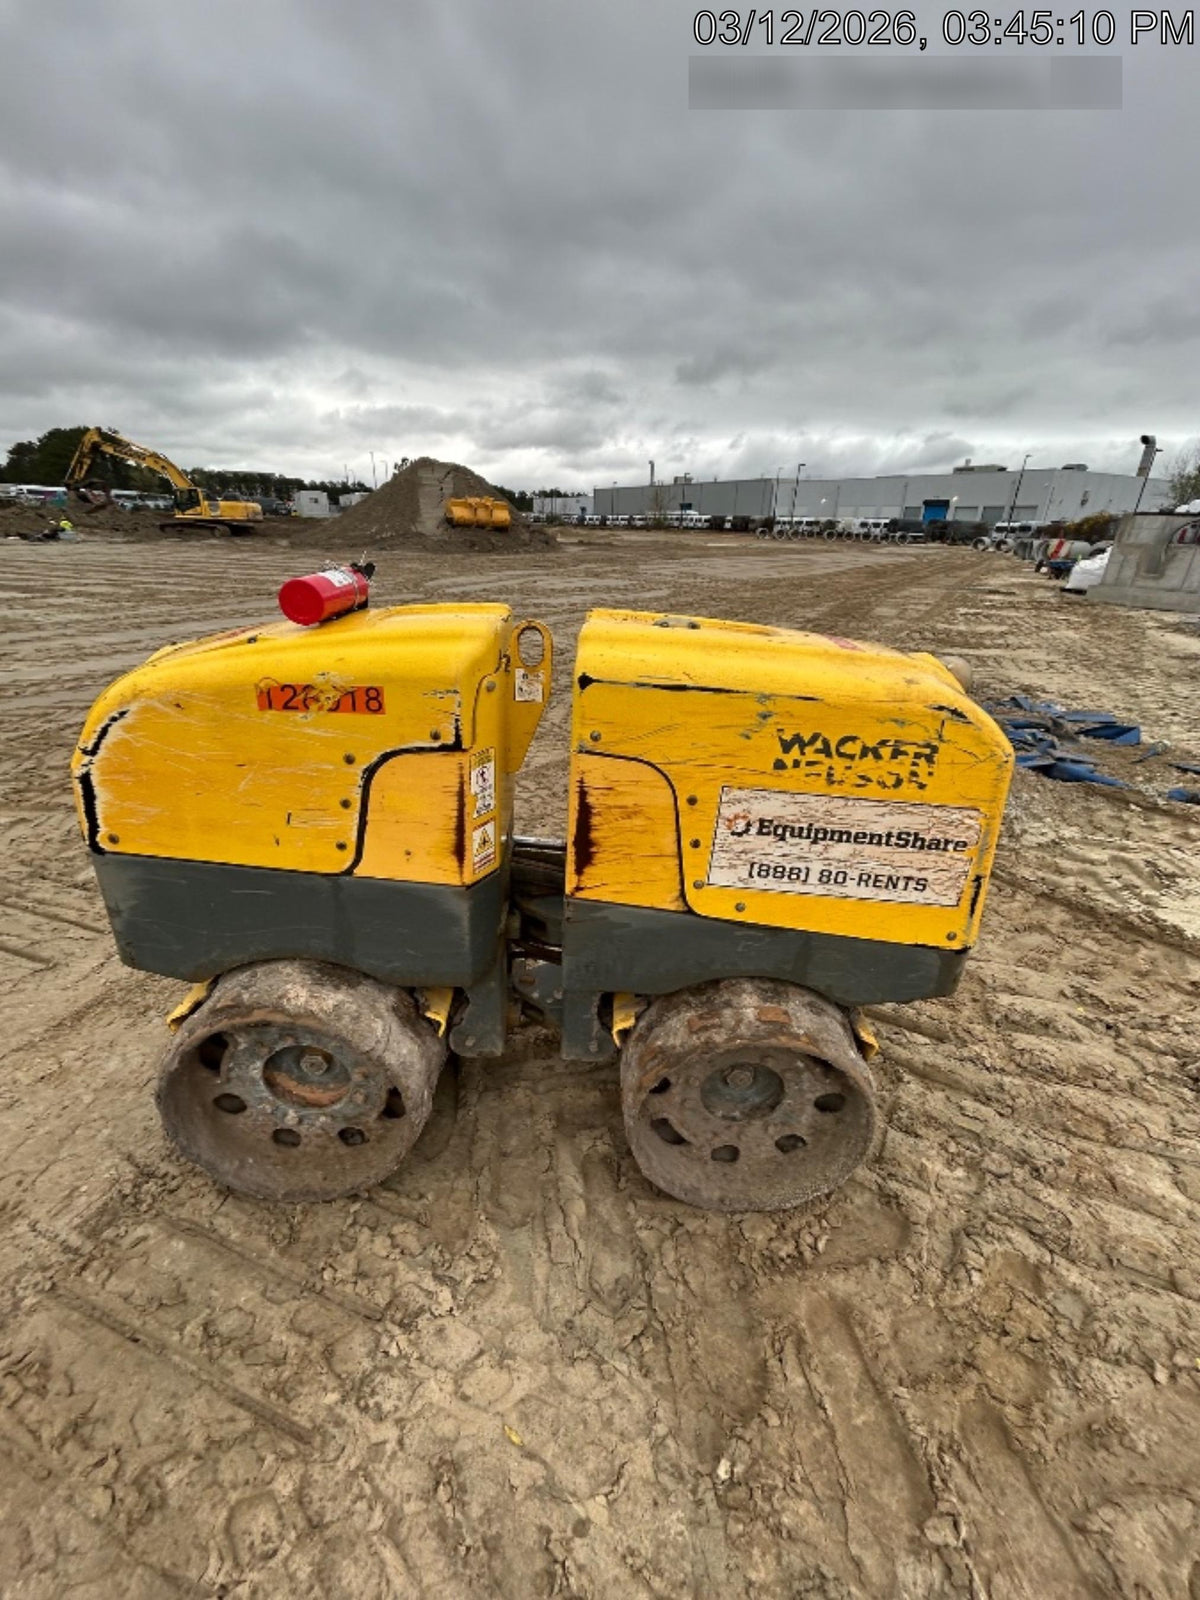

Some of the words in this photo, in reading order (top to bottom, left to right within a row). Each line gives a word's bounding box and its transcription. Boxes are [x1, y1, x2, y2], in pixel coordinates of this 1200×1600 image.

[777, 728, 939, 764] WACKER
[757, 818, 969, 852] EquipmentShare
[817, 869, 929, 893] 80-RENTS
